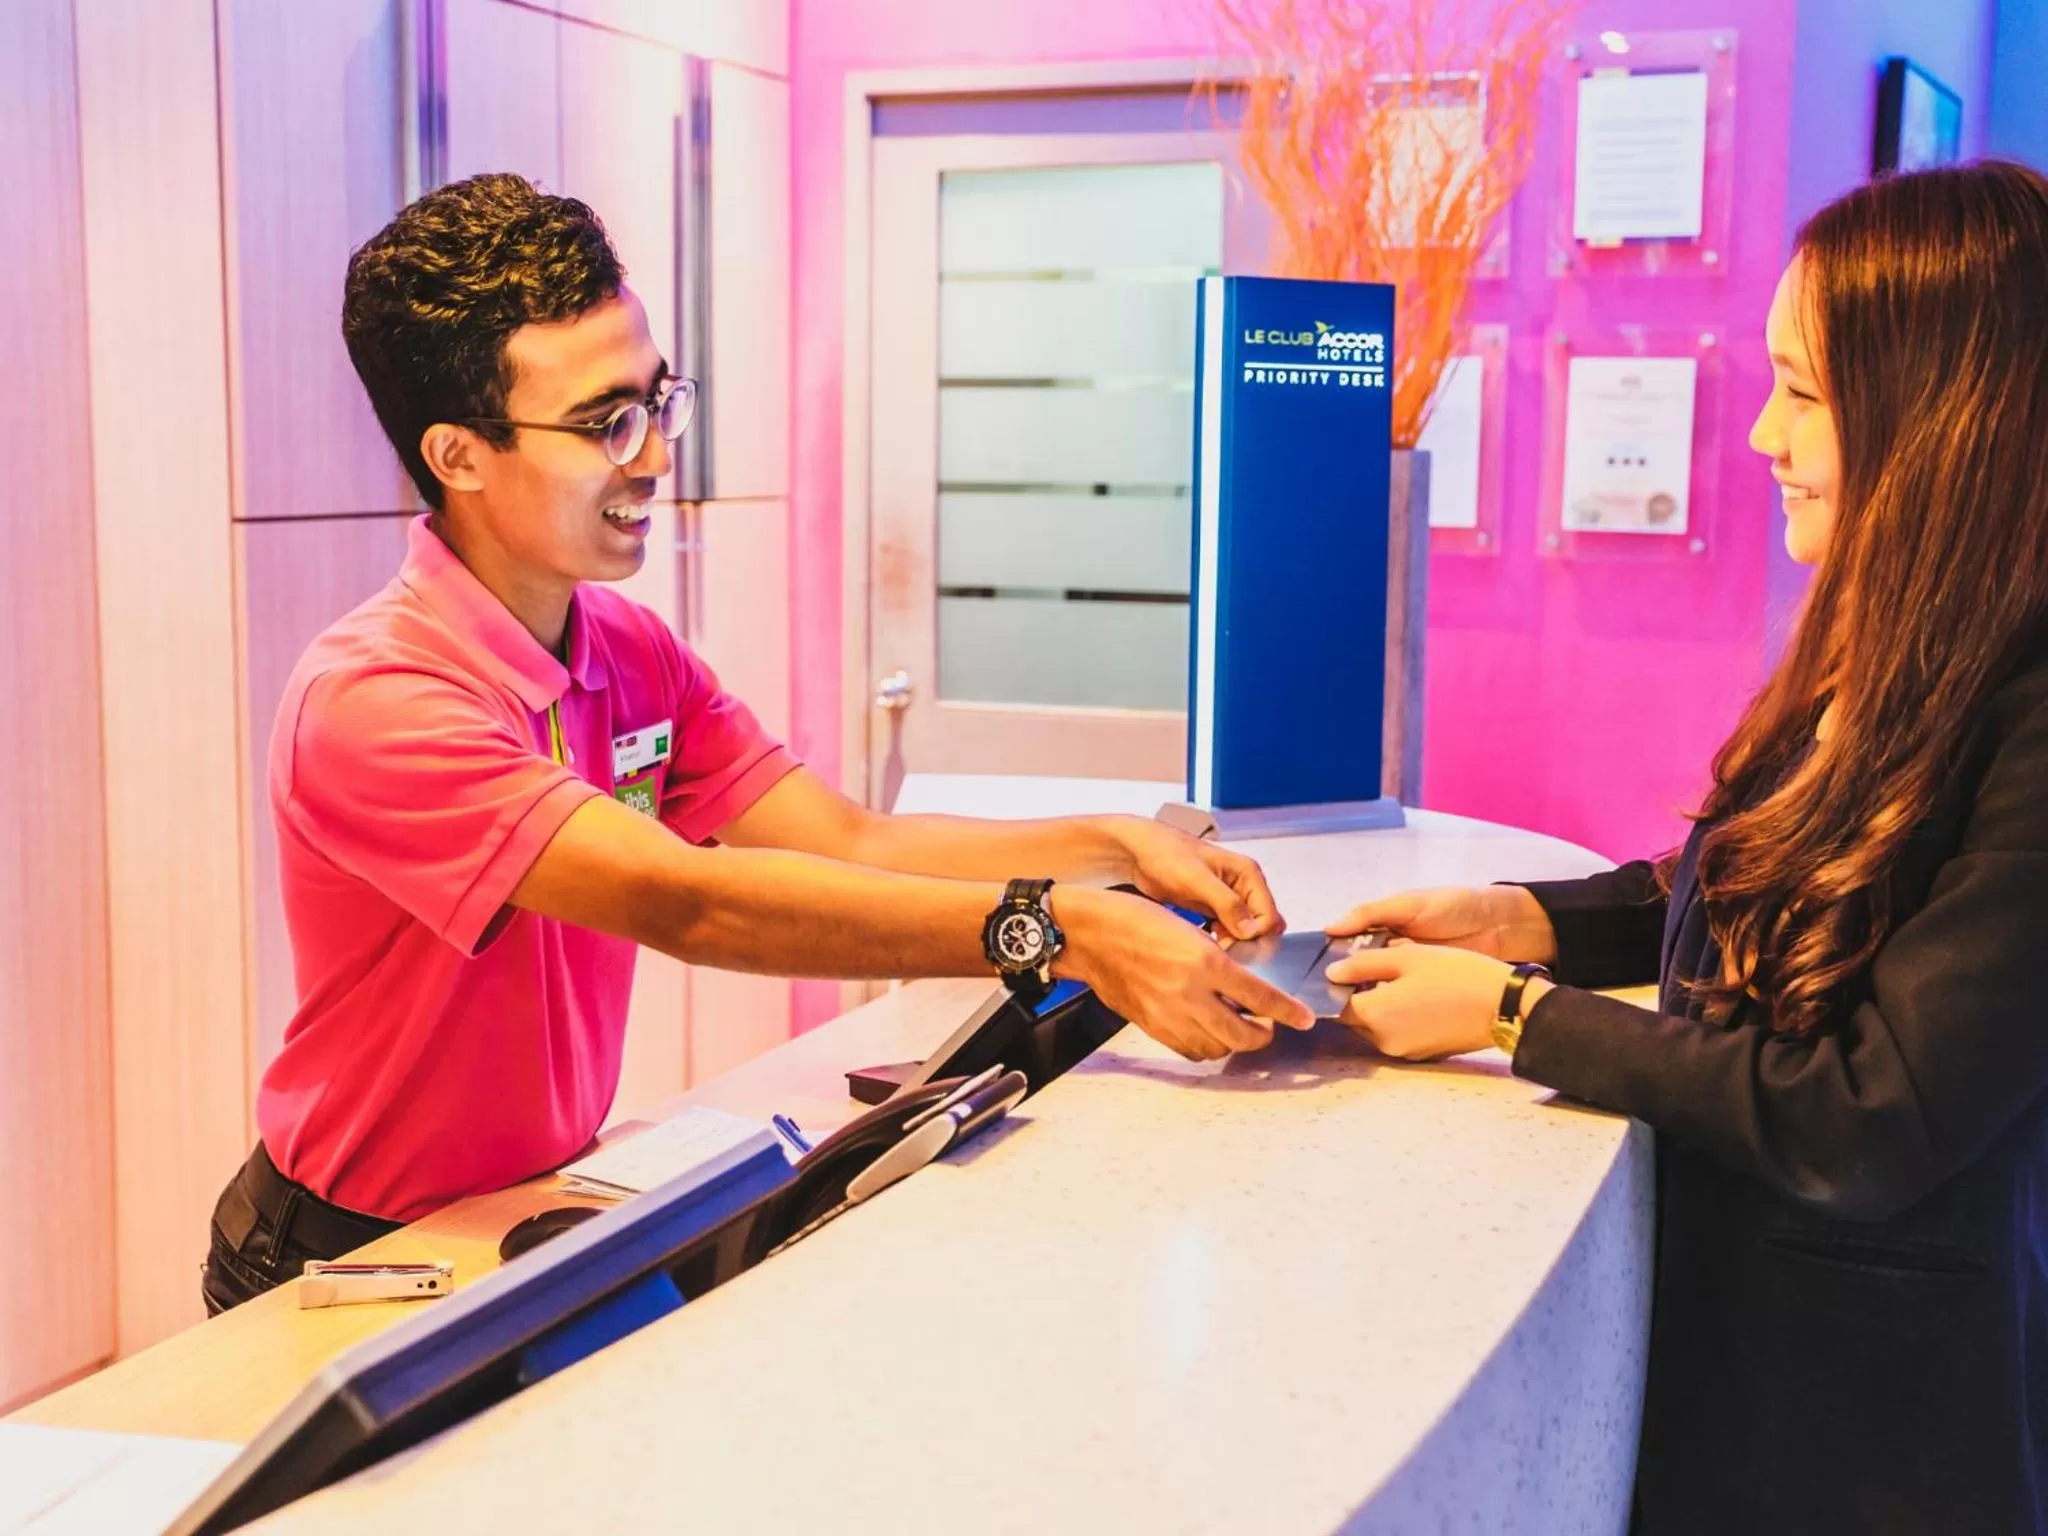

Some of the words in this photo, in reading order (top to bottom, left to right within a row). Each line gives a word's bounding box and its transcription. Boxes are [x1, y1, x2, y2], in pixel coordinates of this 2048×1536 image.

[1244, 329, 1265, 344] LE
[1267, 330, 1314, 346] CLUB
[1317, 331, 1384, 349] ACCOR
[1317, 348, 1384, 363] HOTELS
[1243, 369, 1330, 385] PRIORITY
[1339, 373, 1384, 387] DESK
